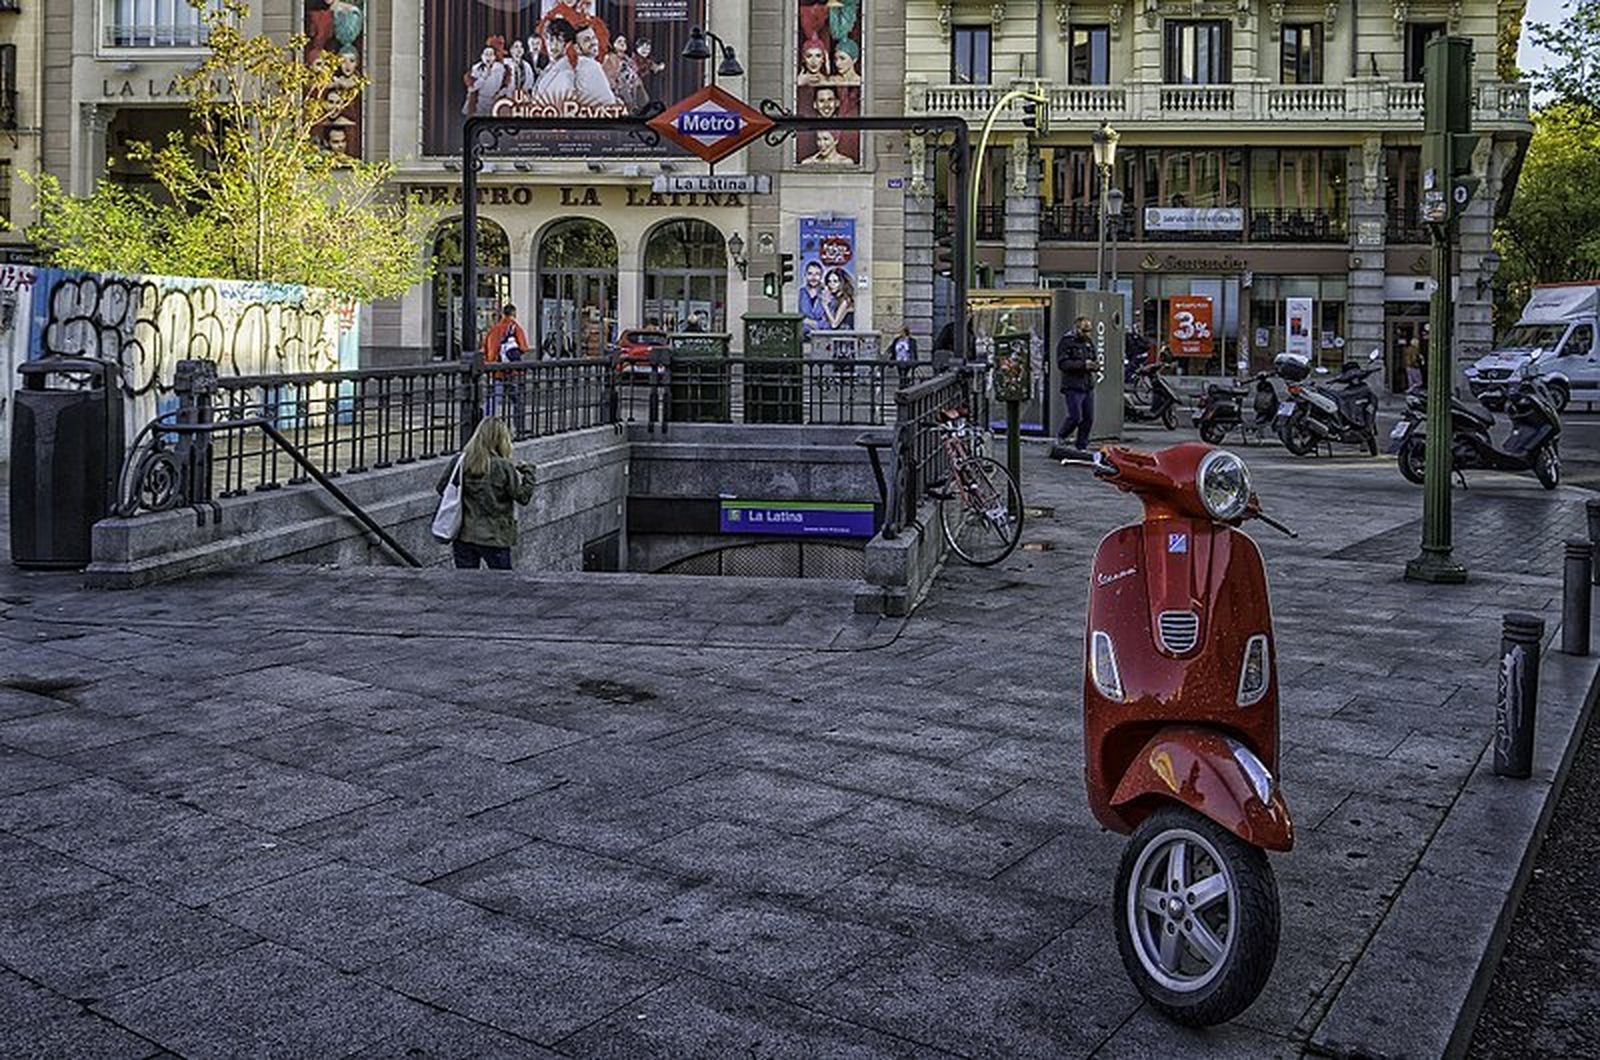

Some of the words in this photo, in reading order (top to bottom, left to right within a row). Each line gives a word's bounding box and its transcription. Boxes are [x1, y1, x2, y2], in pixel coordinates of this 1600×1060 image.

[103, 79, 134, 97] LA
[682, 114, 736, 132] Metro
[674, 176, 694, 191] La
[699, 176, 748, 191] Latina
[559, 187, 602, 207] LA
[625, 187, 745, 207] LATINA
[1173, 311, 1211, 340] 3%
[748, 510, 763, 522] La
[767, 510, 804, 523] Latina
